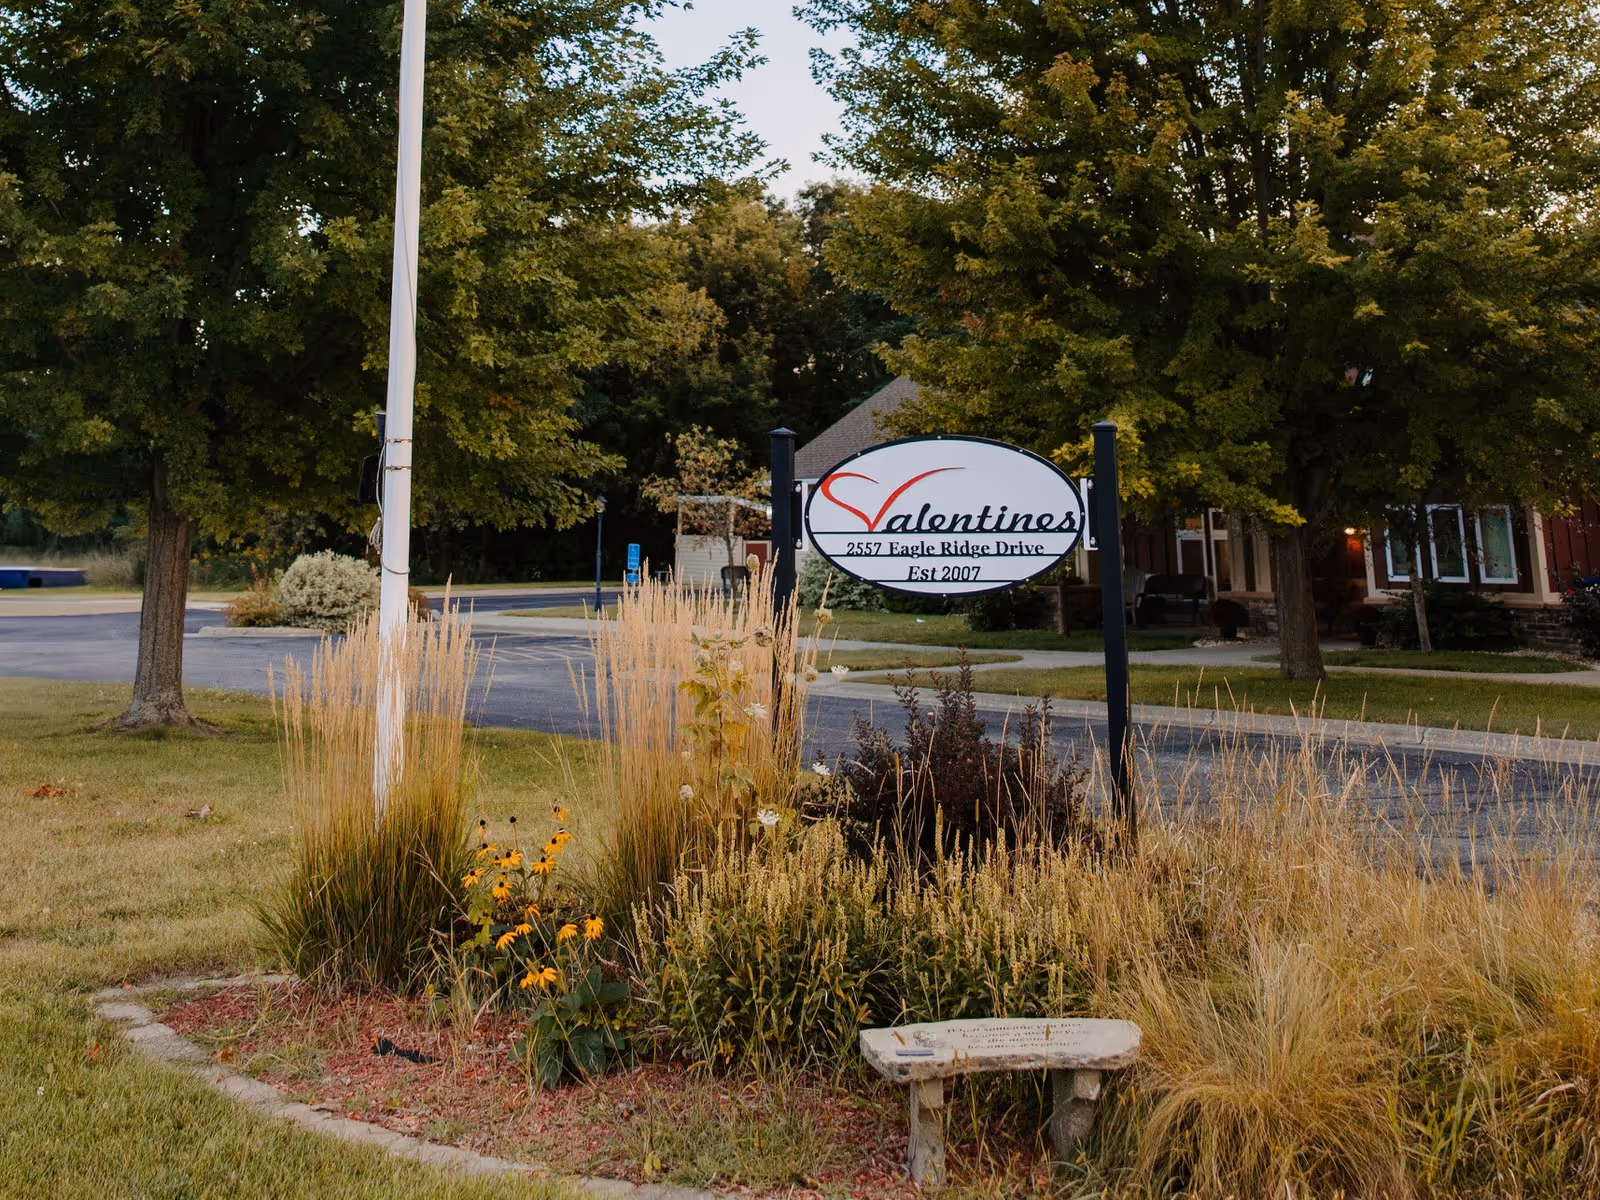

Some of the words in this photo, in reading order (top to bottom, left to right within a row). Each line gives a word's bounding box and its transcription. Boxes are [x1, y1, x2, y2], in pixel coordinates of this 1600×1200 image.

[820, 467, 1077, 532] Valentines
[846, 542, 882, 556] 2557
[888, 540, 935, 559] Eagle
[940, 540, 990, 559] Ridge
[995, 540, 1044, 555] Drive
[907, 565, 938, 581] Est
[941, 565, 981, 581] 2007
